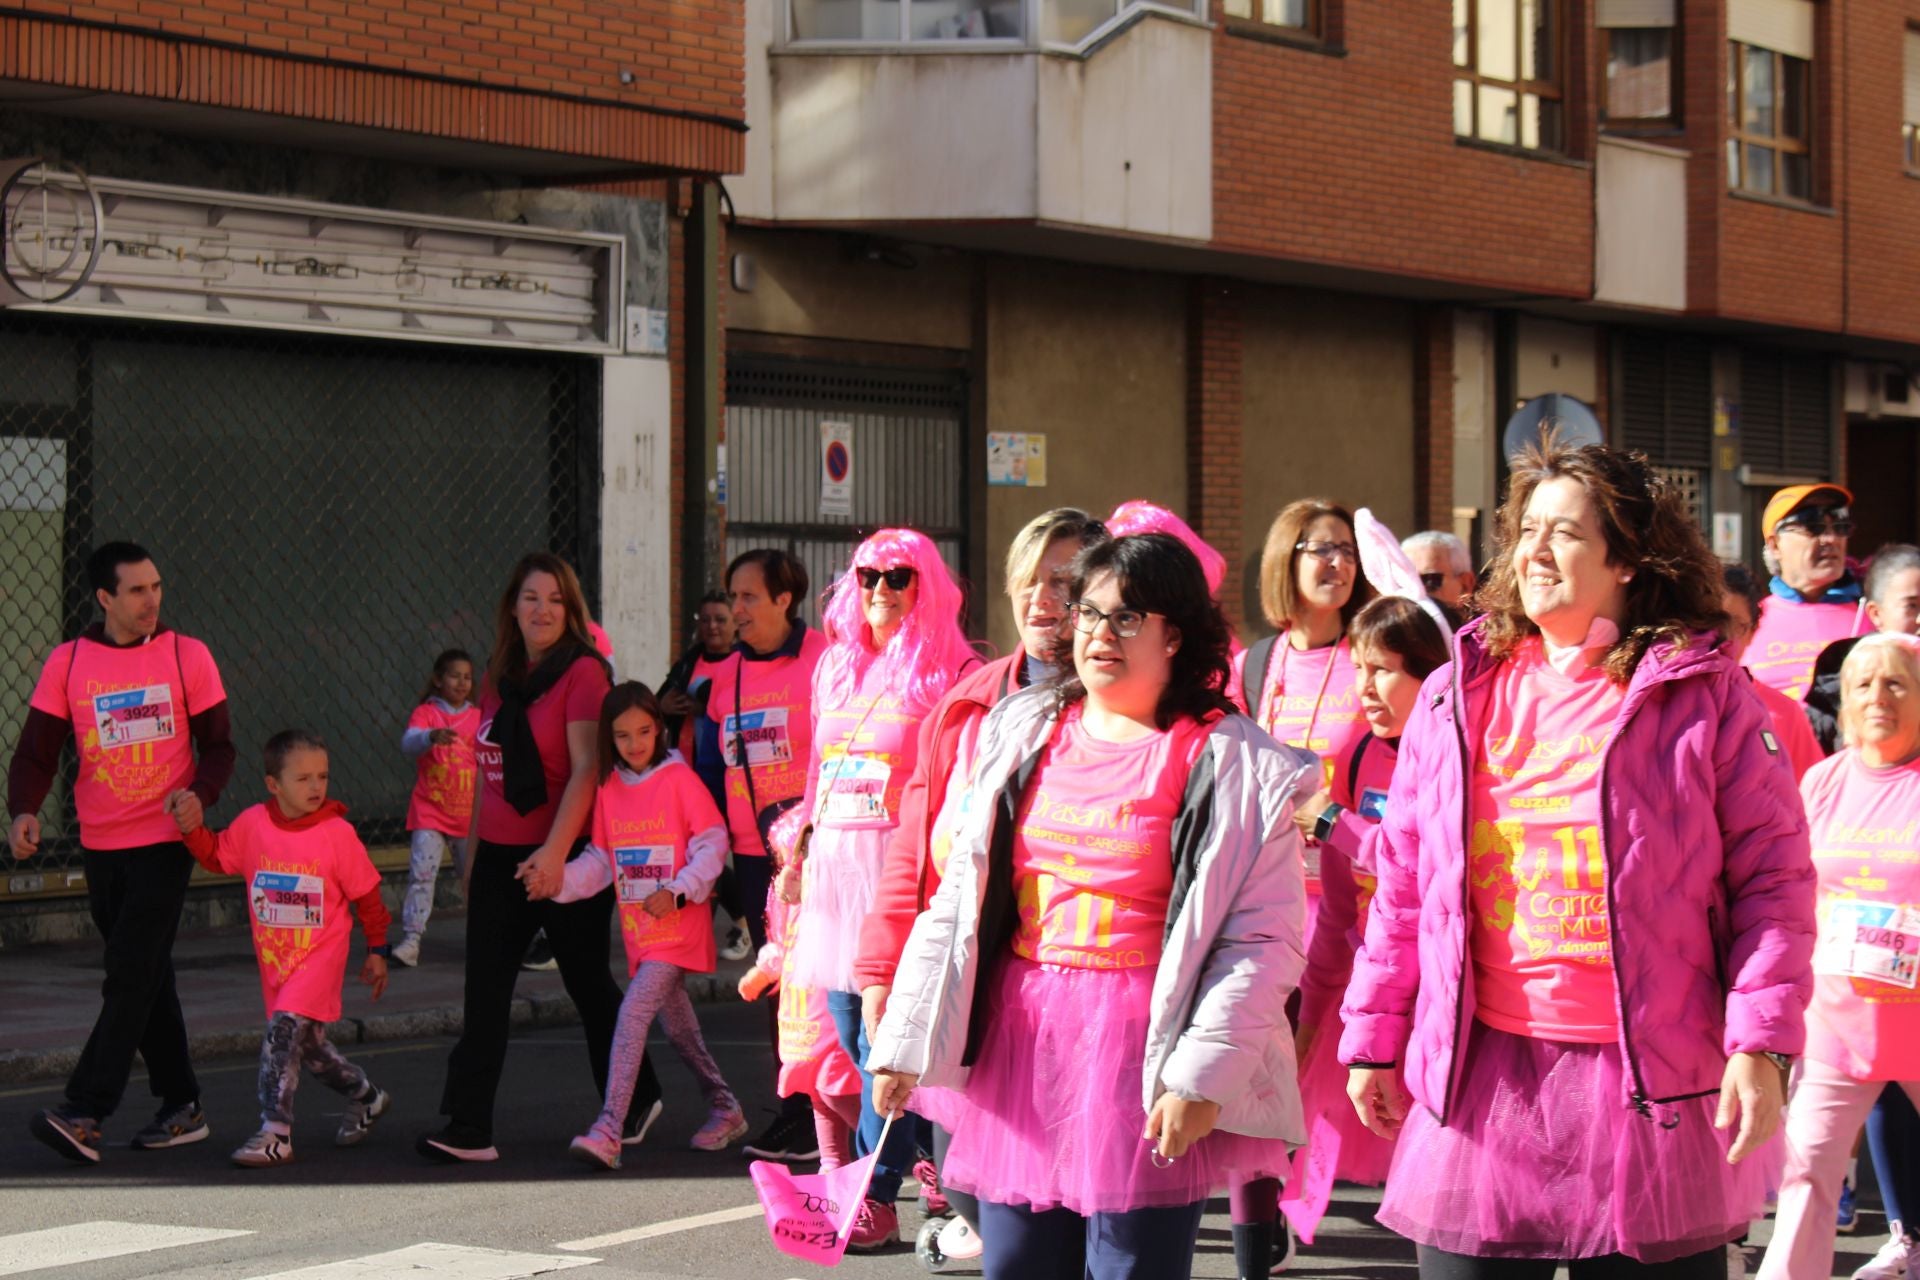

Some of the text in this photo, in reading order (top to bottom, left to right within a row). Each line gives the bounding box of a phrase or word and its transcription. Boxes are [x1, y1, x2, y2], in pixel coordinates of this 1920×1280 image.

[123, 704, 159, 721] 3922
[743, 727, 777, 743] 3840
[1509, 796, 1570, 809] SUZUKI
[1084, 835, 1152, 855] CAROBELS
[631, 867, 663, 879] 3833
[275, 891, 309, 905] 3924
[1856, 927, 1905, 950] 2046
[1040, 945, 1145, 969] Carrera
